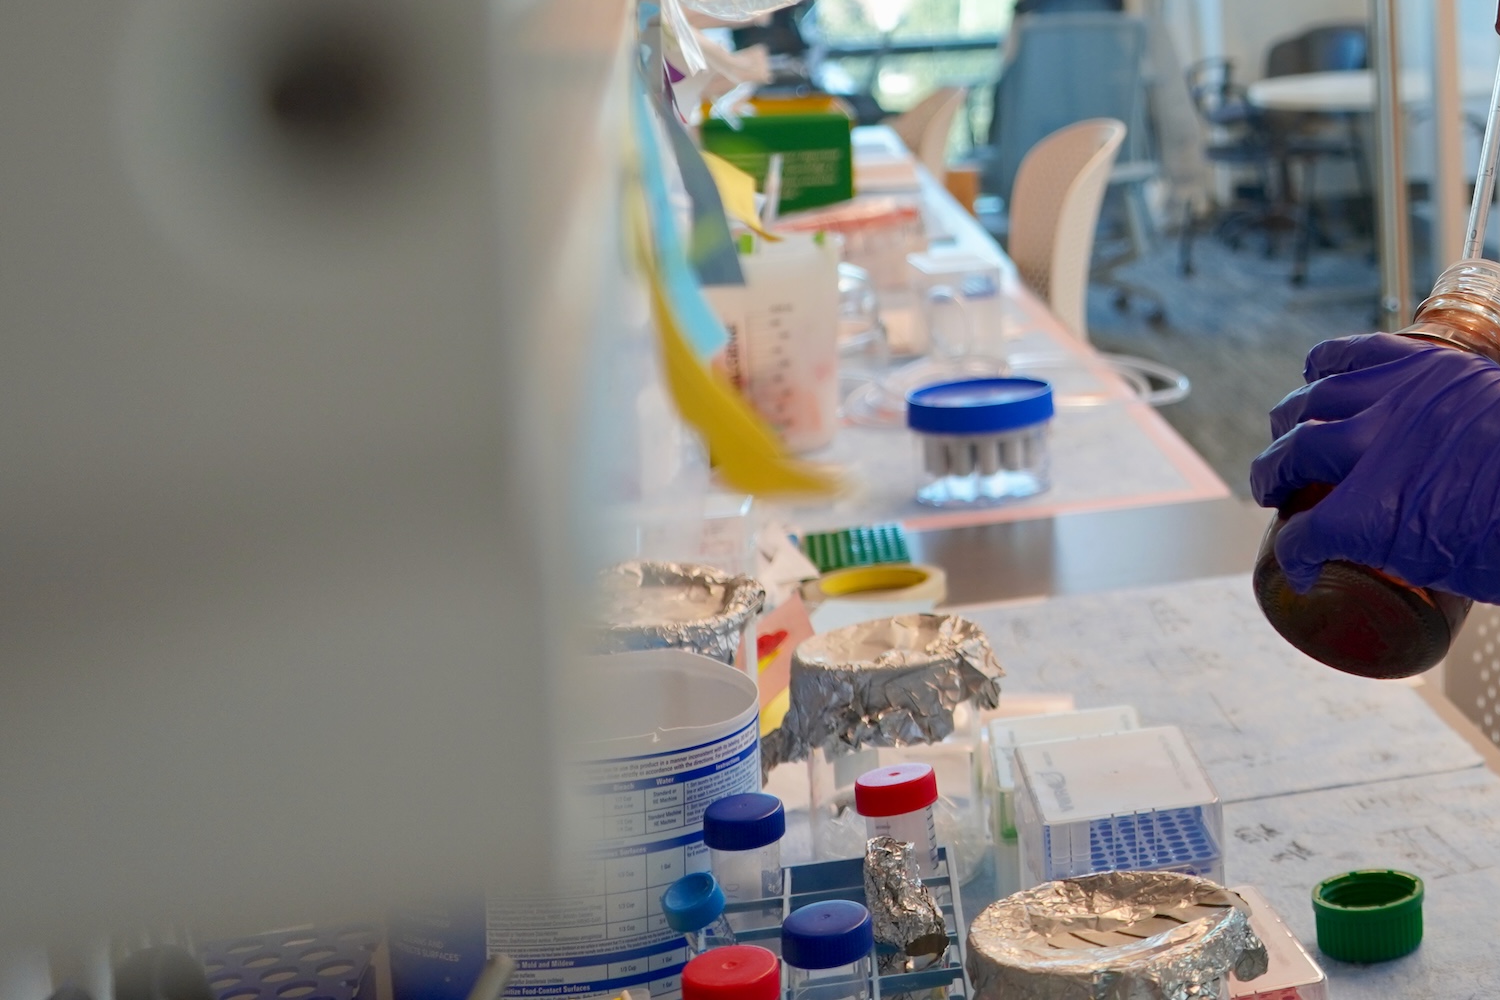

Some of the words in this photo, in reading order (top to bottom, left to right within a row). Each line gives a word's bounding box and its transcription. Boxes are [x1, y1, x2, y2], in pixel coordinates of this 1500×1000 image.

[640, 762, 658, 770] product
[646, 766, 673, 775] accordance
[656, 777, 674, 785] Water
[716, 756, 740, 770] Instructions
[522, 986, 562, 994] Food-Contact
[563, 985, 590, 993] Surfaces
